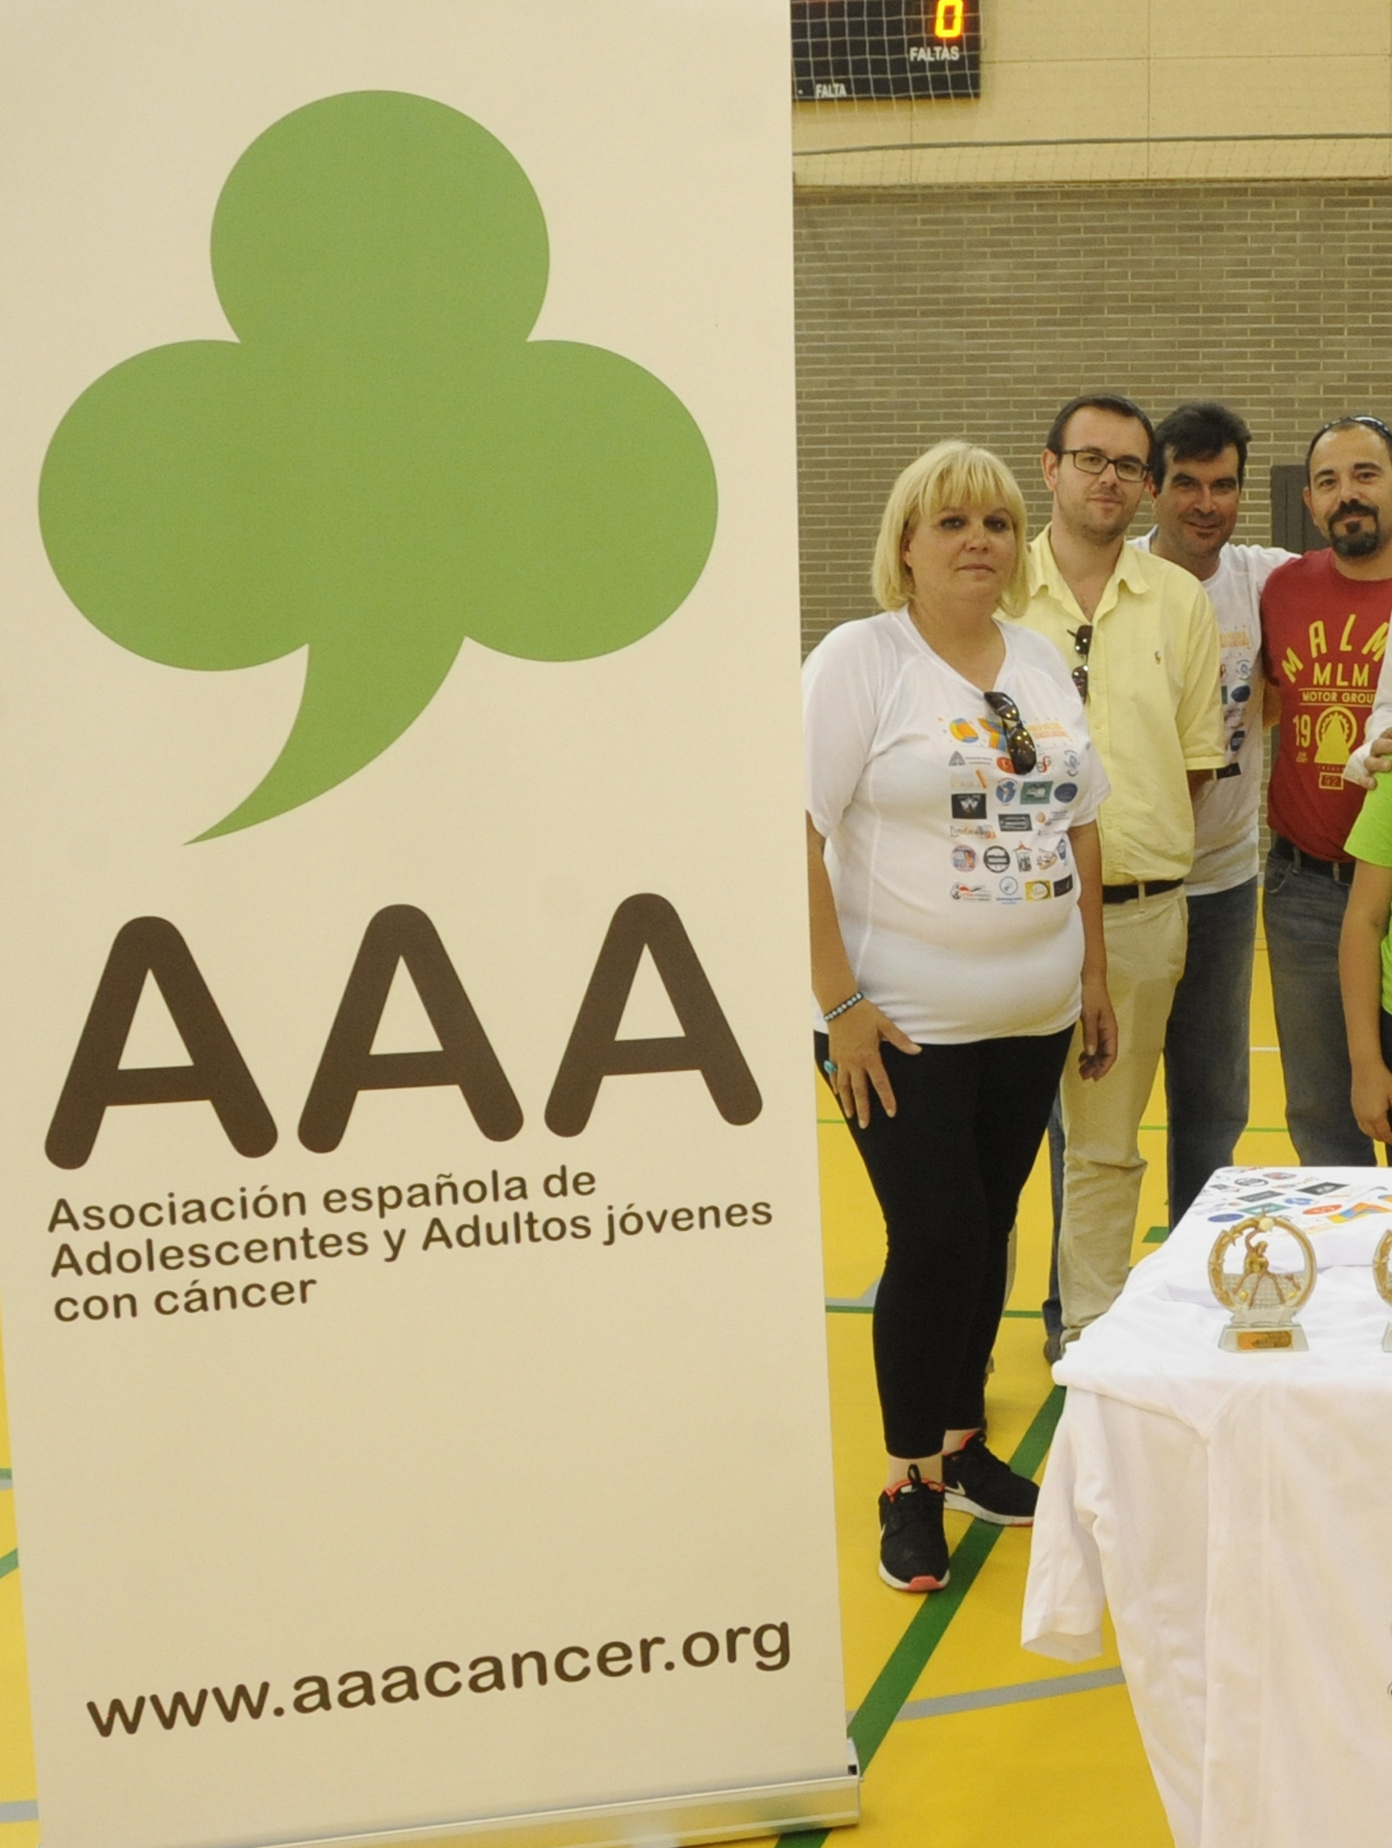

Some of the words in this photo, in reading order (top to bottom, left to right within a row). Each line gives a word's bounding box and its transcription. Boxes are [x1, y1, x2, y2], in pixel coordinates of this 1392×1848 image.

[935, 0, 963, 38] 0
[908, 46, 960, 61] FALTAS
[815, 83, 847, 98] FALTA
[1281, 613, 1390, 684] MALM
[1312, 662, 1370, 687] MLM
[1302, 690, 1338, 702] MOTOR
[1341, 691, 1376, 704] GROU
[1292, 714, 1312, 748] 19
[44, 891, 764, 1171] AAA
[47, 1182, 308, 1234] Asociación
[321, 1169, 530, 1219] española
[541, 1164, 598, 1199] de
[50, 1226, 370, 1279] Adolescentes
[383, 1226, 407, 1263] y
[420, 1209, 592, 1253] Adultos
[602, 1197, 775, 1247] jóvenes
[52, 1285, 139, 1323] con
[153, 1273, 318, 1318] cáncer
[86, 1620, 792, 1738] www.aaacancer.org
